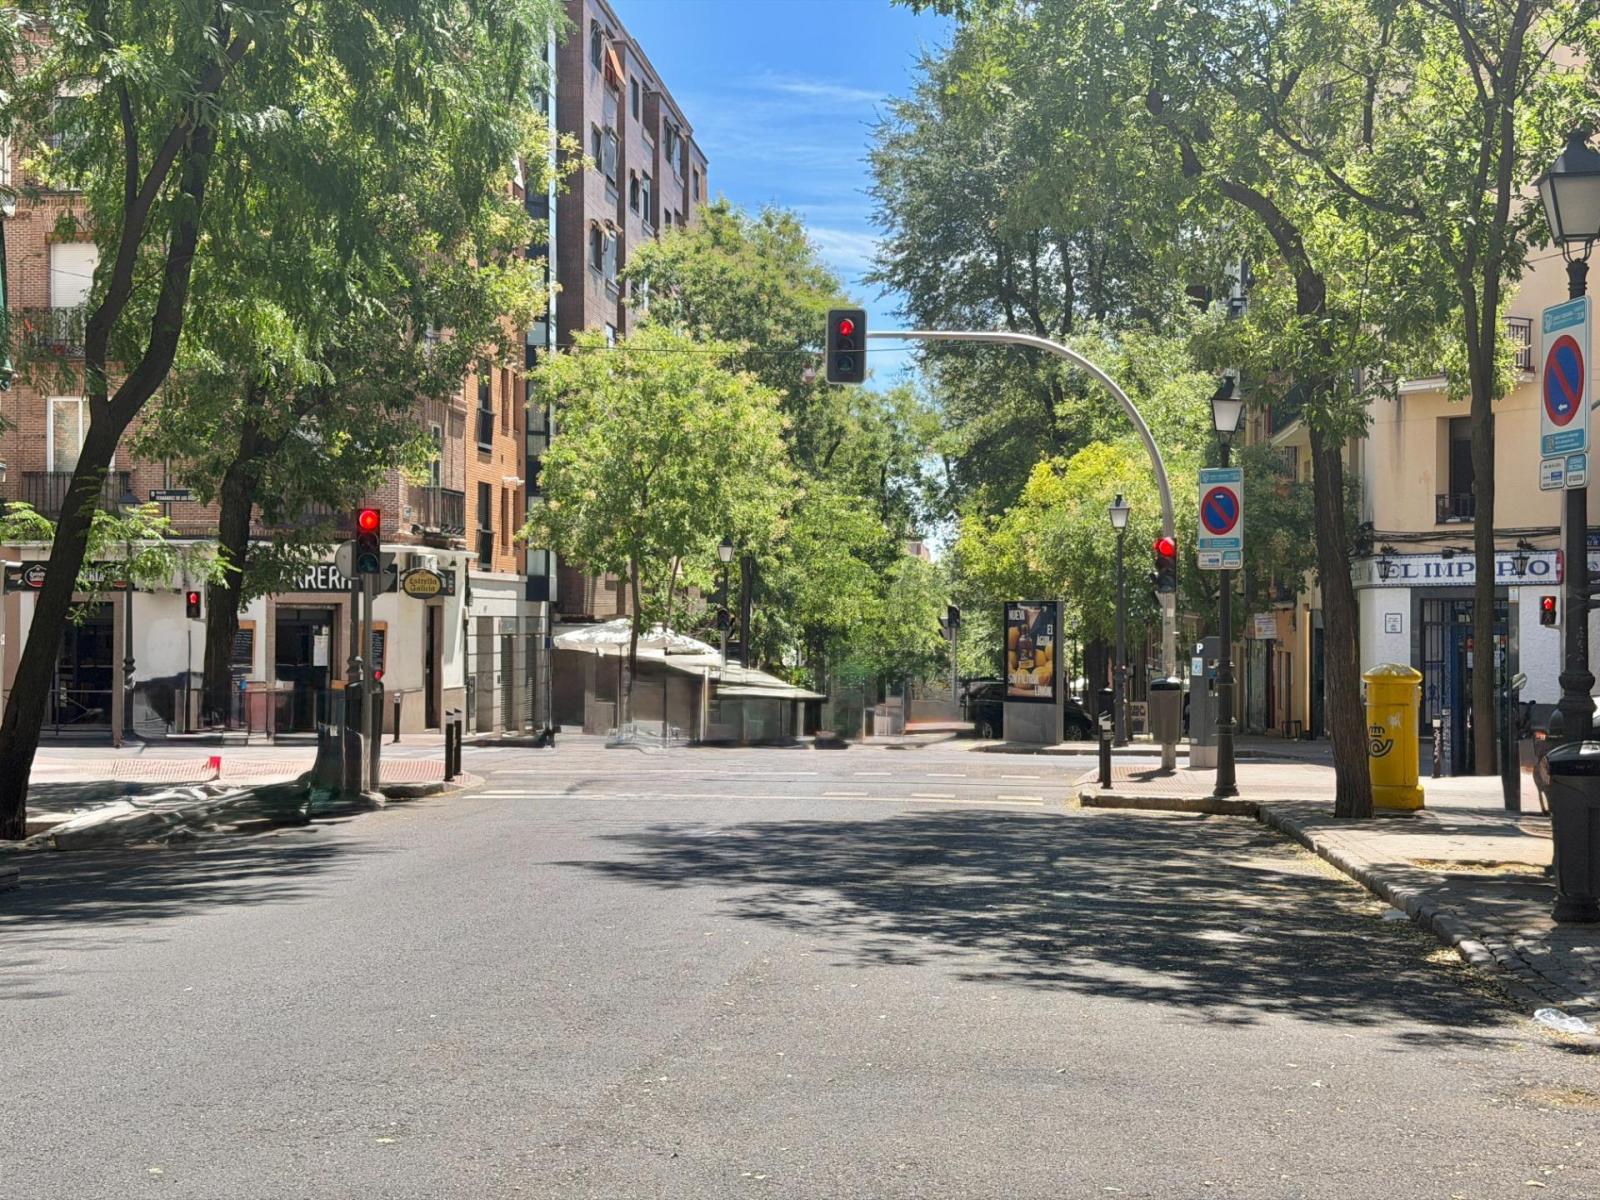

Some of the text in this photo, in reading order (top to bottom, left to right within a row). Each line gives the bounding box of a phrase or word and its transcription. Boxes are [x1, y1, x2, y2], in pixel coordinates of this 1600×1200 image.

[1424, 560, 1550, 578] IMPRO
[409, 577, 437, 585] Estrella
[1008, 609, 1026, 620] NUEVA
[1196, 643, 1203, 654] P
